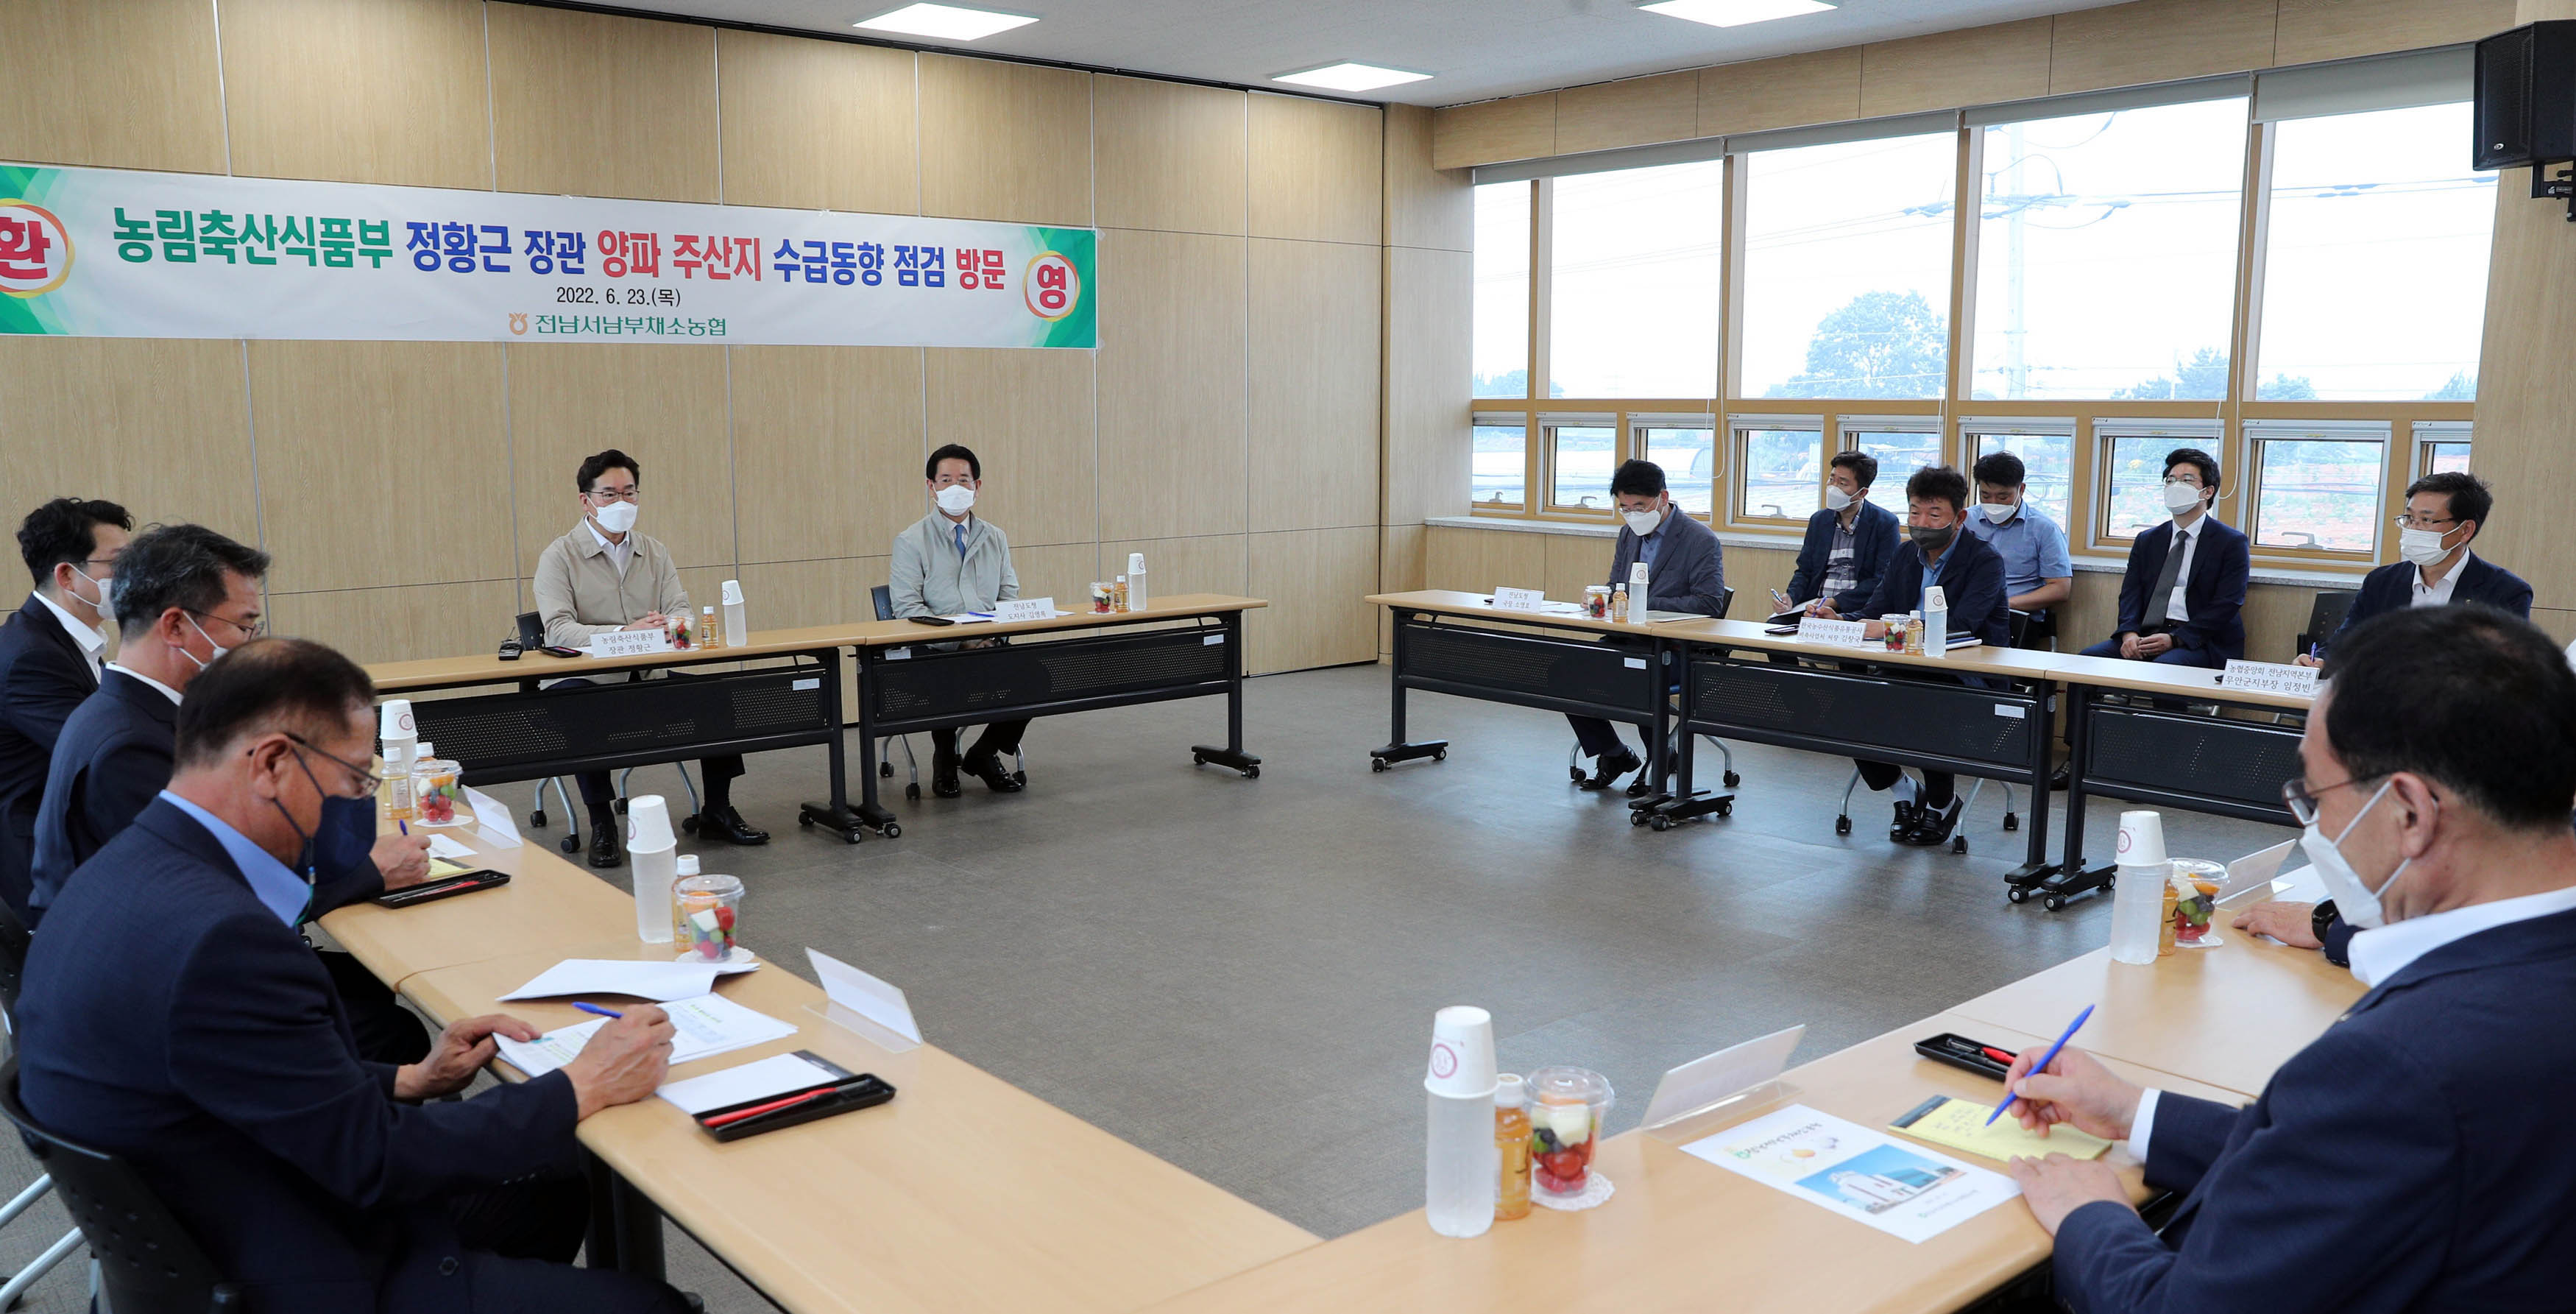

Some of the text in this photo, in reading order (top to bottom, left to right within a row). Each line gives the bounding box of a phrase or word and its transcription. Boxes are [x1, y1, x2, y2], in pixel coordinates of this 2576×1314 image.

[113, 207, 1005, 290] 농림축산식품부 정황근 장관 양파 주산지 수급동향 점검 방문
[1036, 264, 1067, 310] 영
[556, 286, 681, 307] 2022. 6. 23.(목)
[536, 314, 726, 336] 전남서남부채소농협
[1013, 601, 1036, 610] 전남도청
[601, 632, 654, 644] 농림축산식품부
[608, 643, 651, 654] 장관 정황근
[2229, 665, 2313, 679] 농협중앙회 전남지역본부
[2226, 676, 2310, 693] 무안군지부장 임정빈
